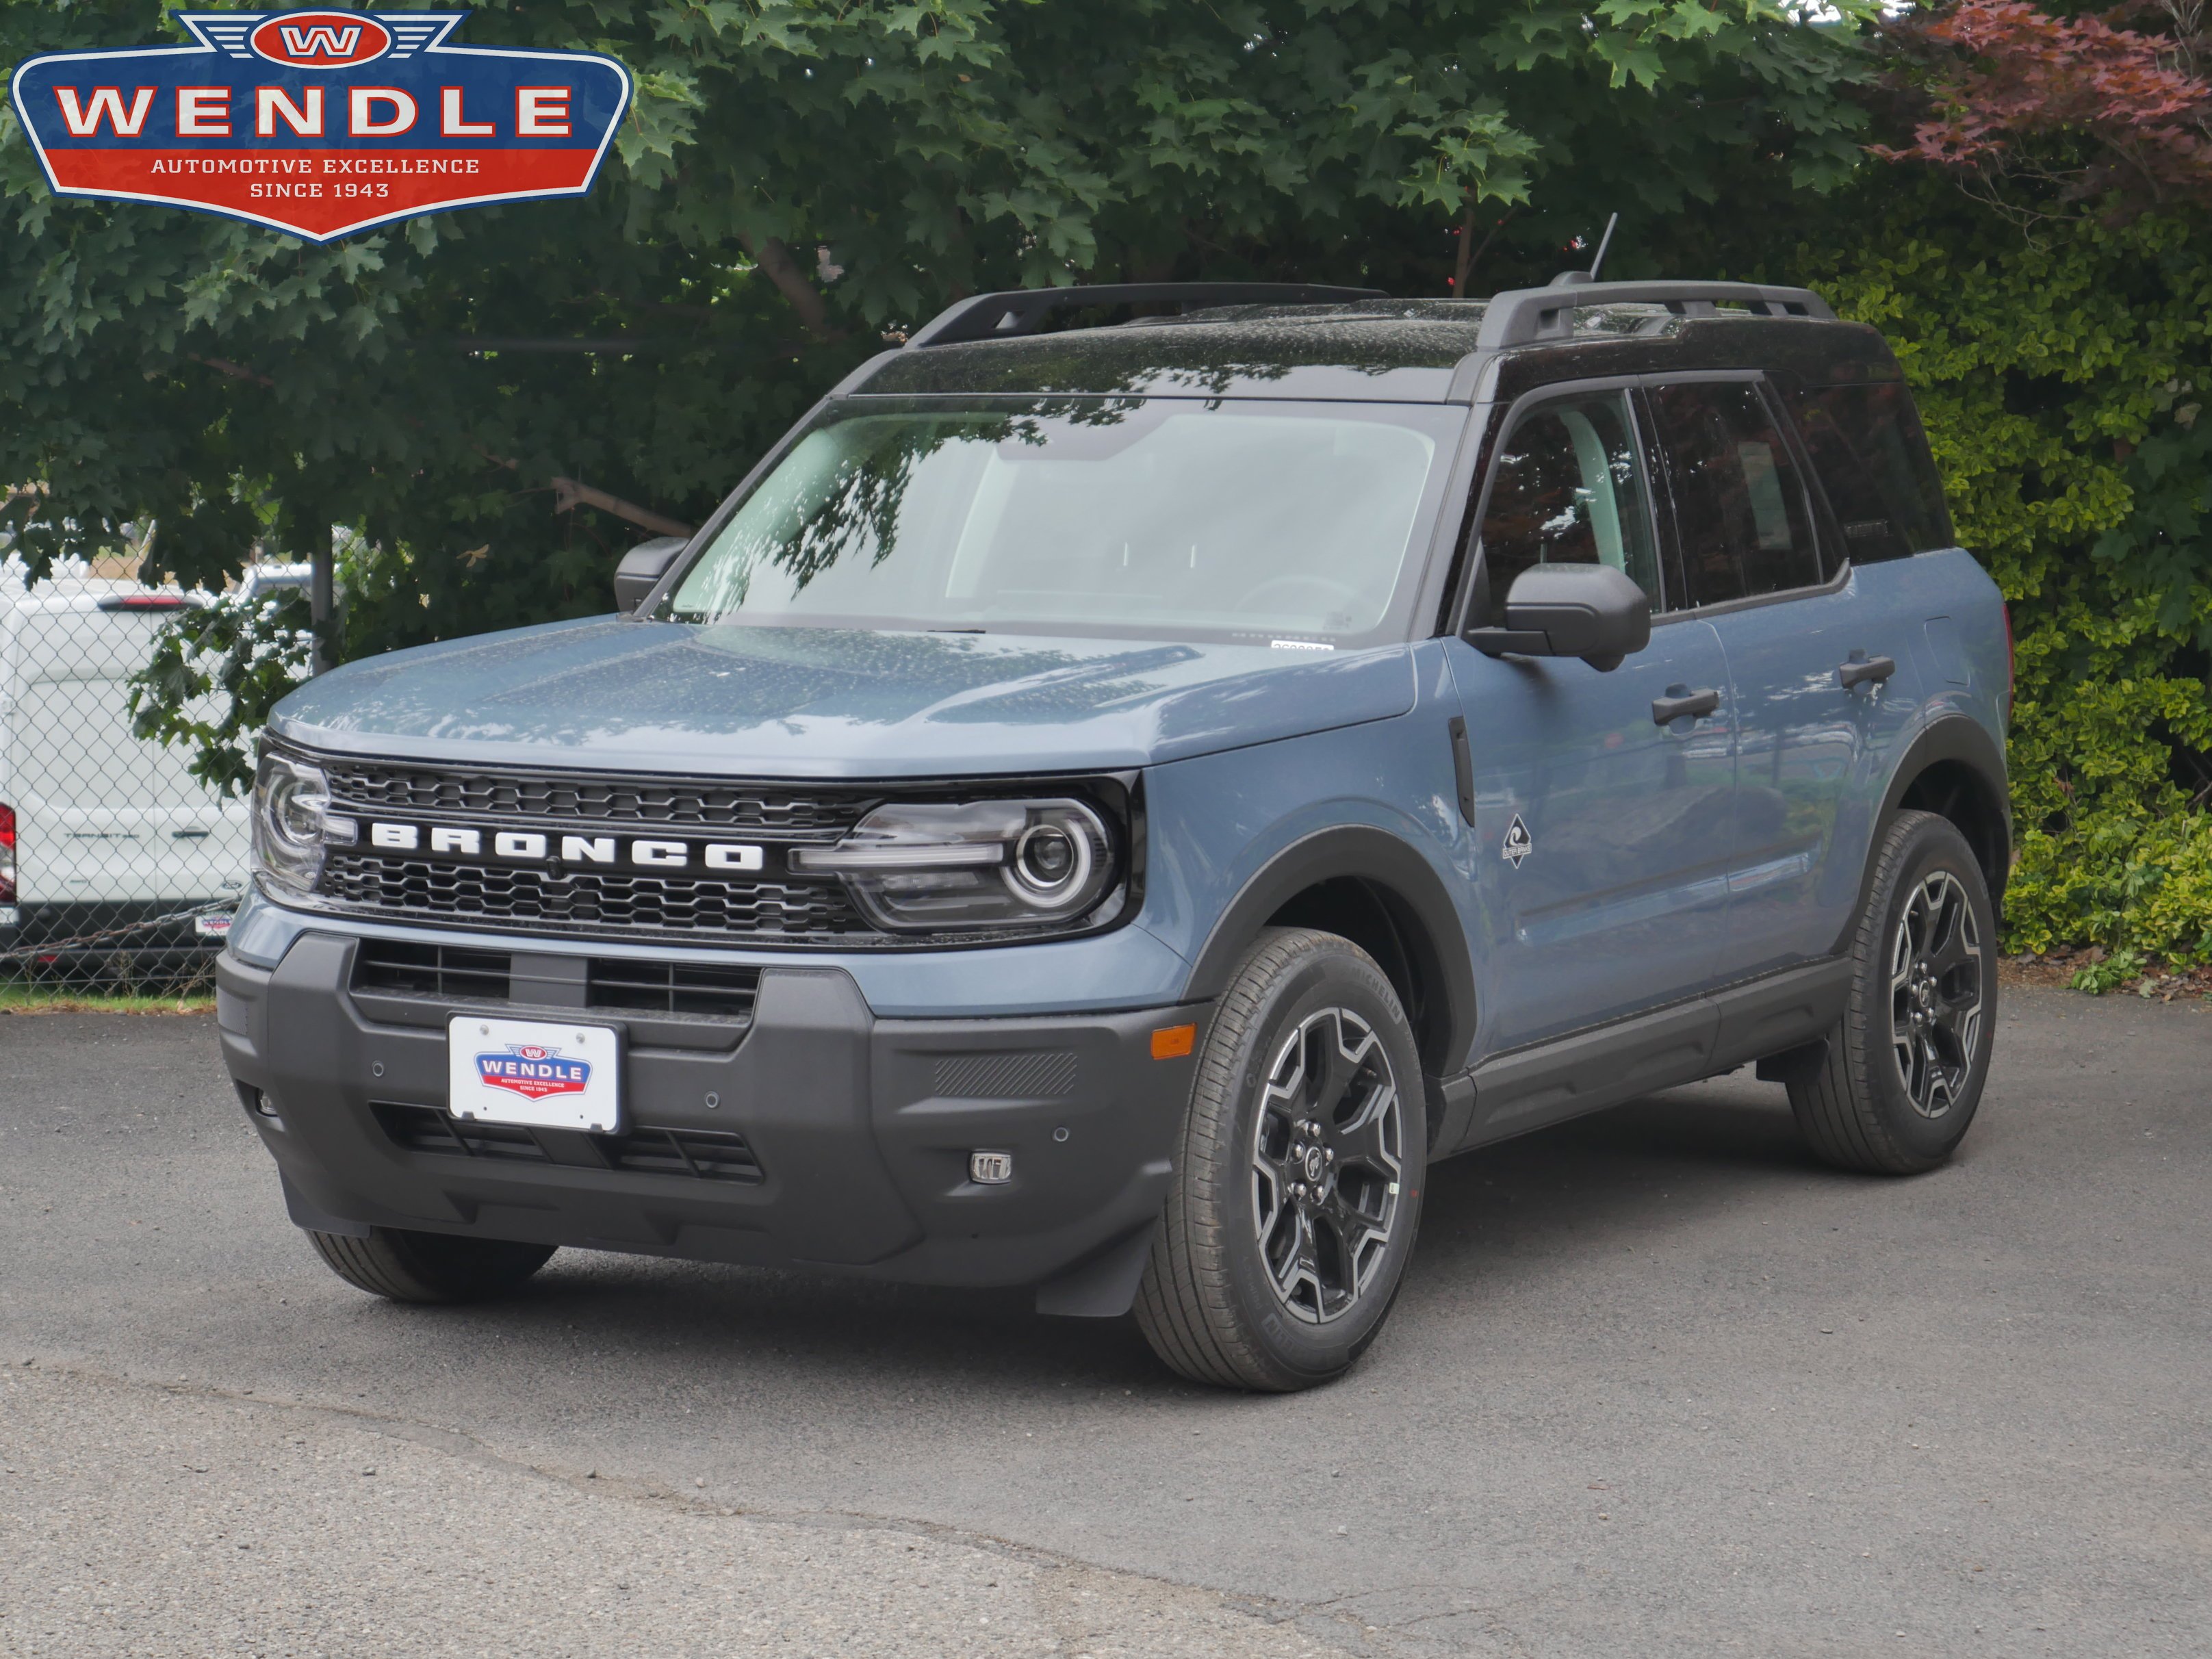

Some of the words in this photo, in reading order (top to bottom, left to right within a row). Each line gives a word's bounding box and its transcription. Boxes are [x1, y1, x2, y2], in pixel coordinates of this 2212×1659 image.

[372, 823, 763, 870] BRONCO
[1352, 967, 1400, 1014] MICHELIN
[483, 1060, 581, 1080] WENDLE
